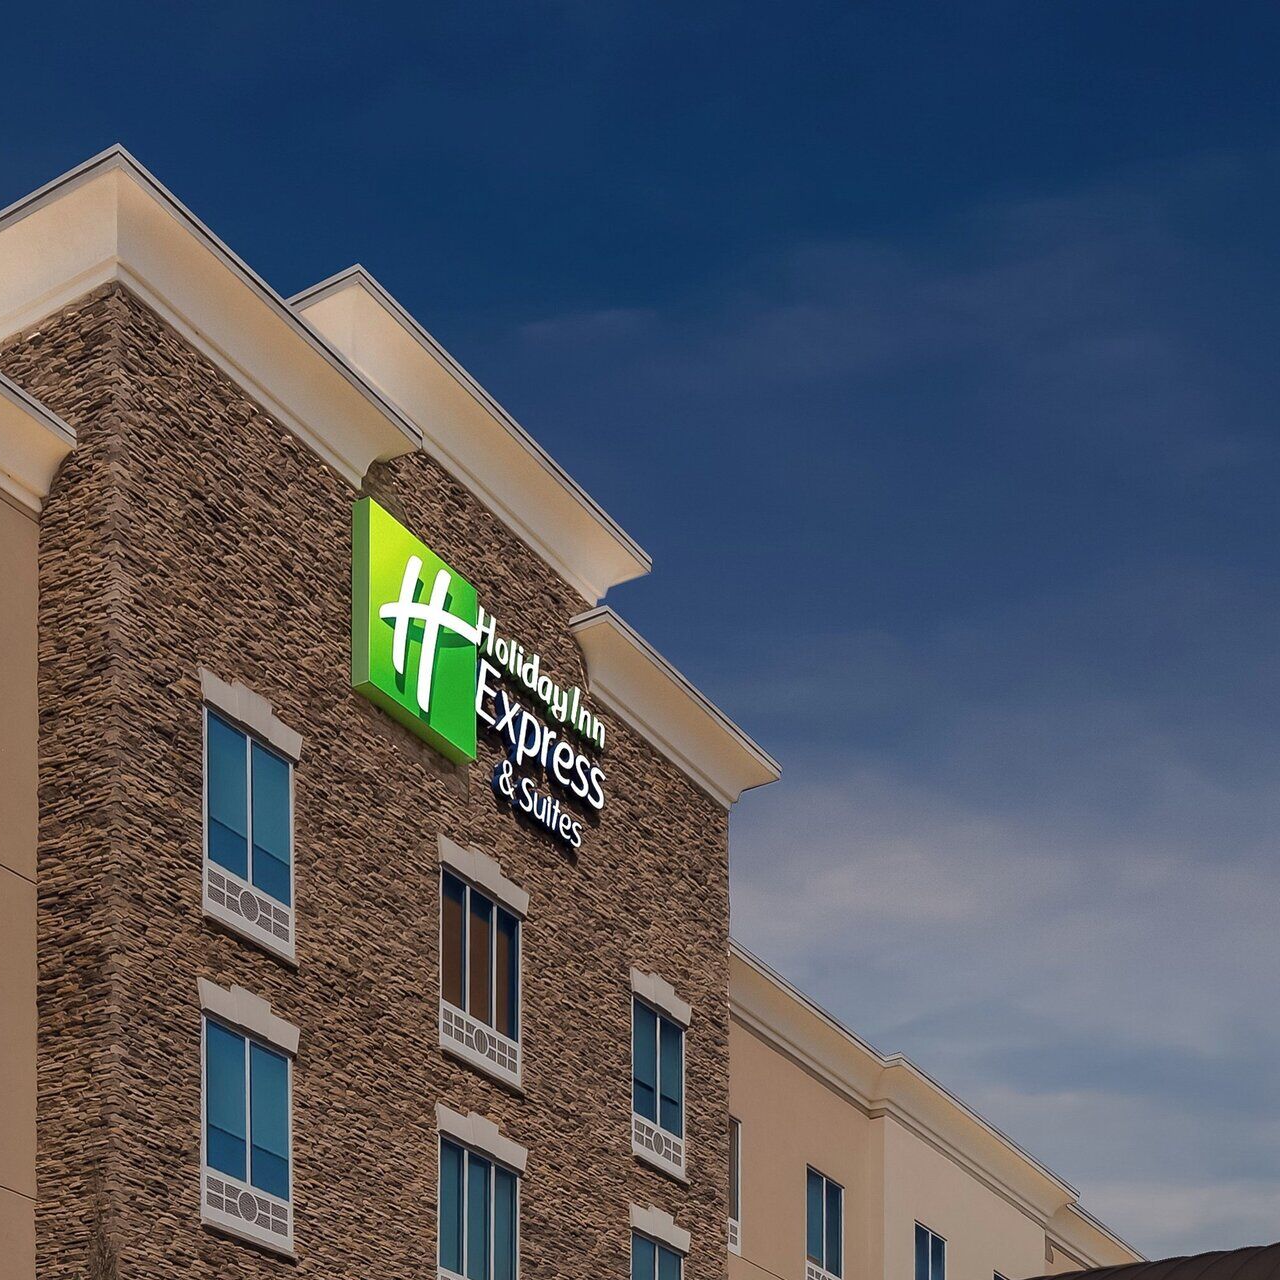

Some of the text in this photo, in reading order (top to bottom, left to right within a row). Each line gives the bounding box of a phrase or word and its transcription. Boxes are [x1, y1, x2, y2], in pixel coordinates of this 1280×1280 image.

[475, 658, 606, 810] Express
[498, 759, 582, 848] & Suites
